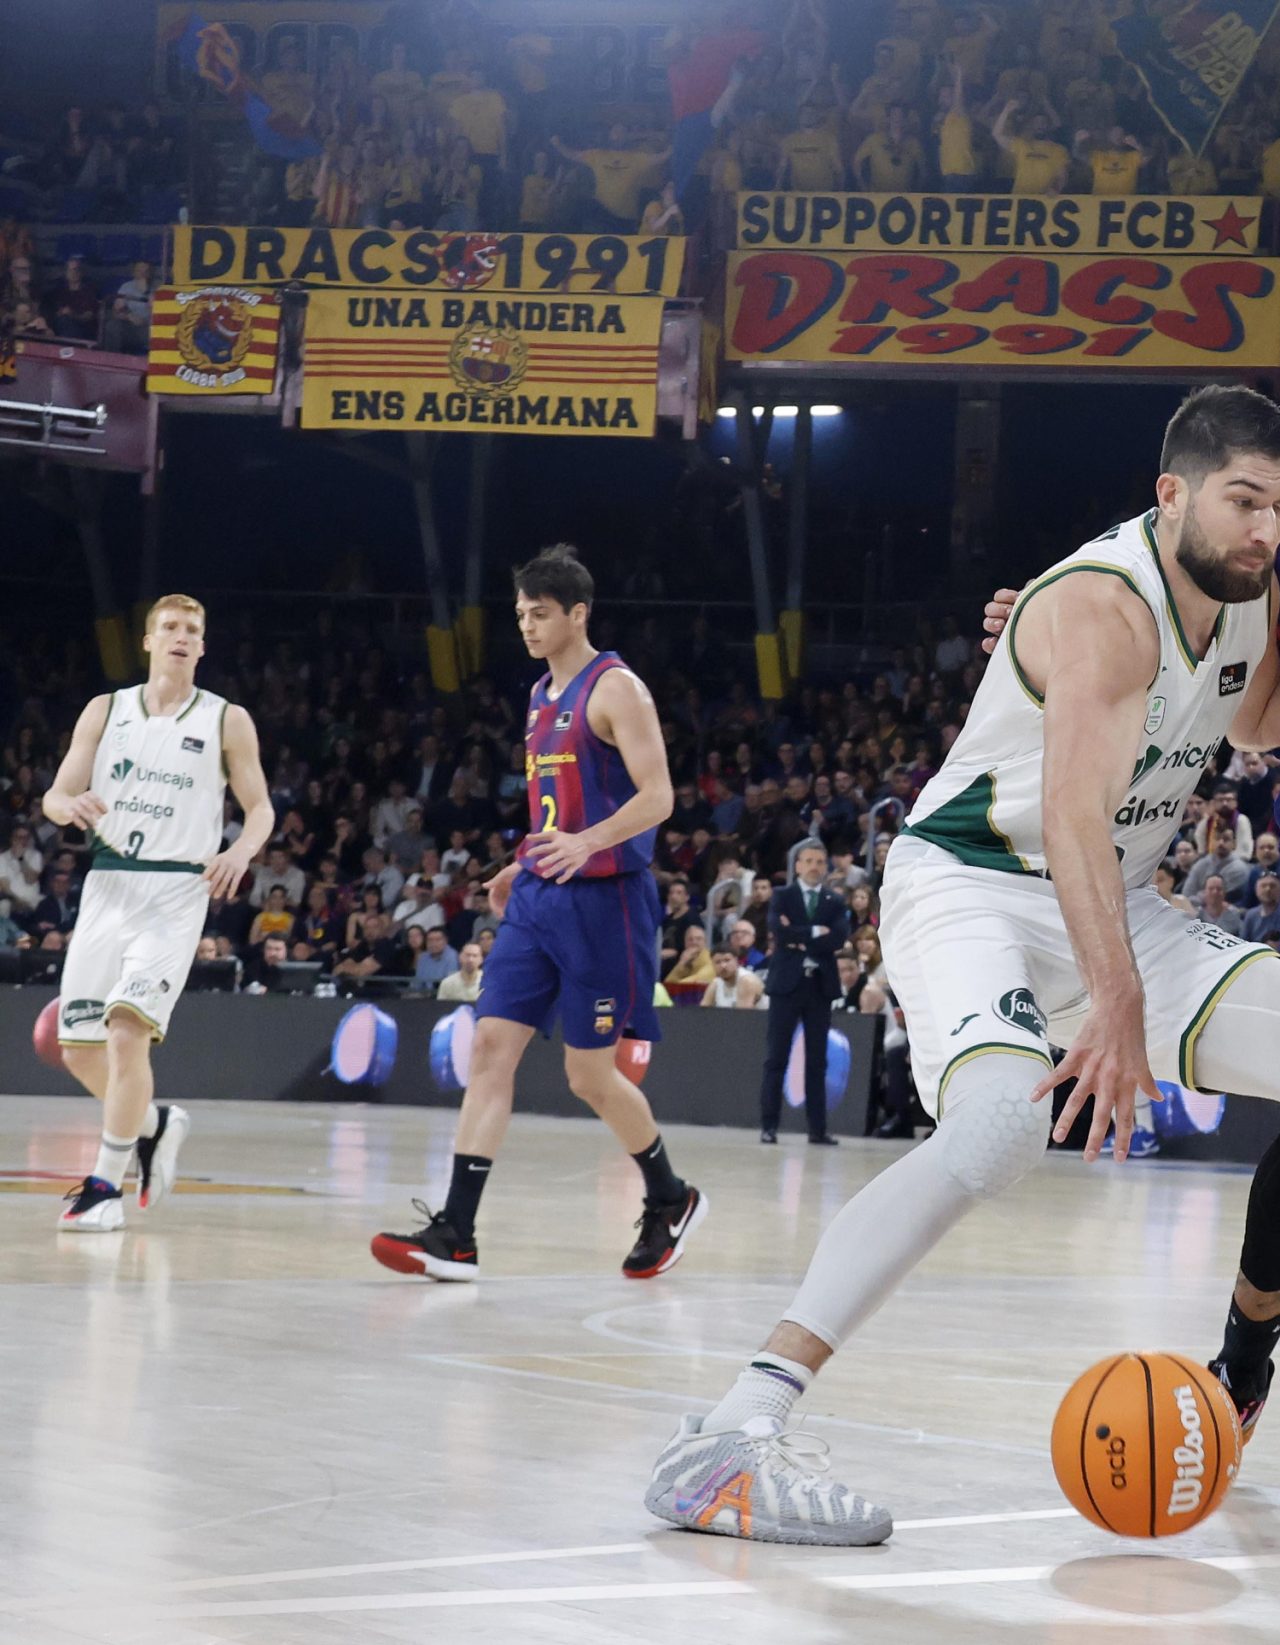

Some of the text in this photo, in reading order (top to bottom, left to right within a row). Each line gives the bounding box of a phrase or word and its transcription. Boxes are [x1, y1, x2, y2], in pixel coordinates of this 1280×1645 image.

[741, 195, 1195, 248] SUPPORTERS FCB
[190, 227, 669, 291] DRACS 1991
[348, 298, 626, 333] UNA BANDERA
[731, 253, 1275, 353] DRACS
[829, 323, 1153, 356] 1991
[331, 390, 638, 428] ENS AGERMANA
[136, 767, 194, 791] Unicaja
[114, 796, 175, 819] málaga
[541, 795, 558, 833] 2
[1106, 1436, 1128, 1490] acb
[1167, 1384, 1206, 1517] Wilson
